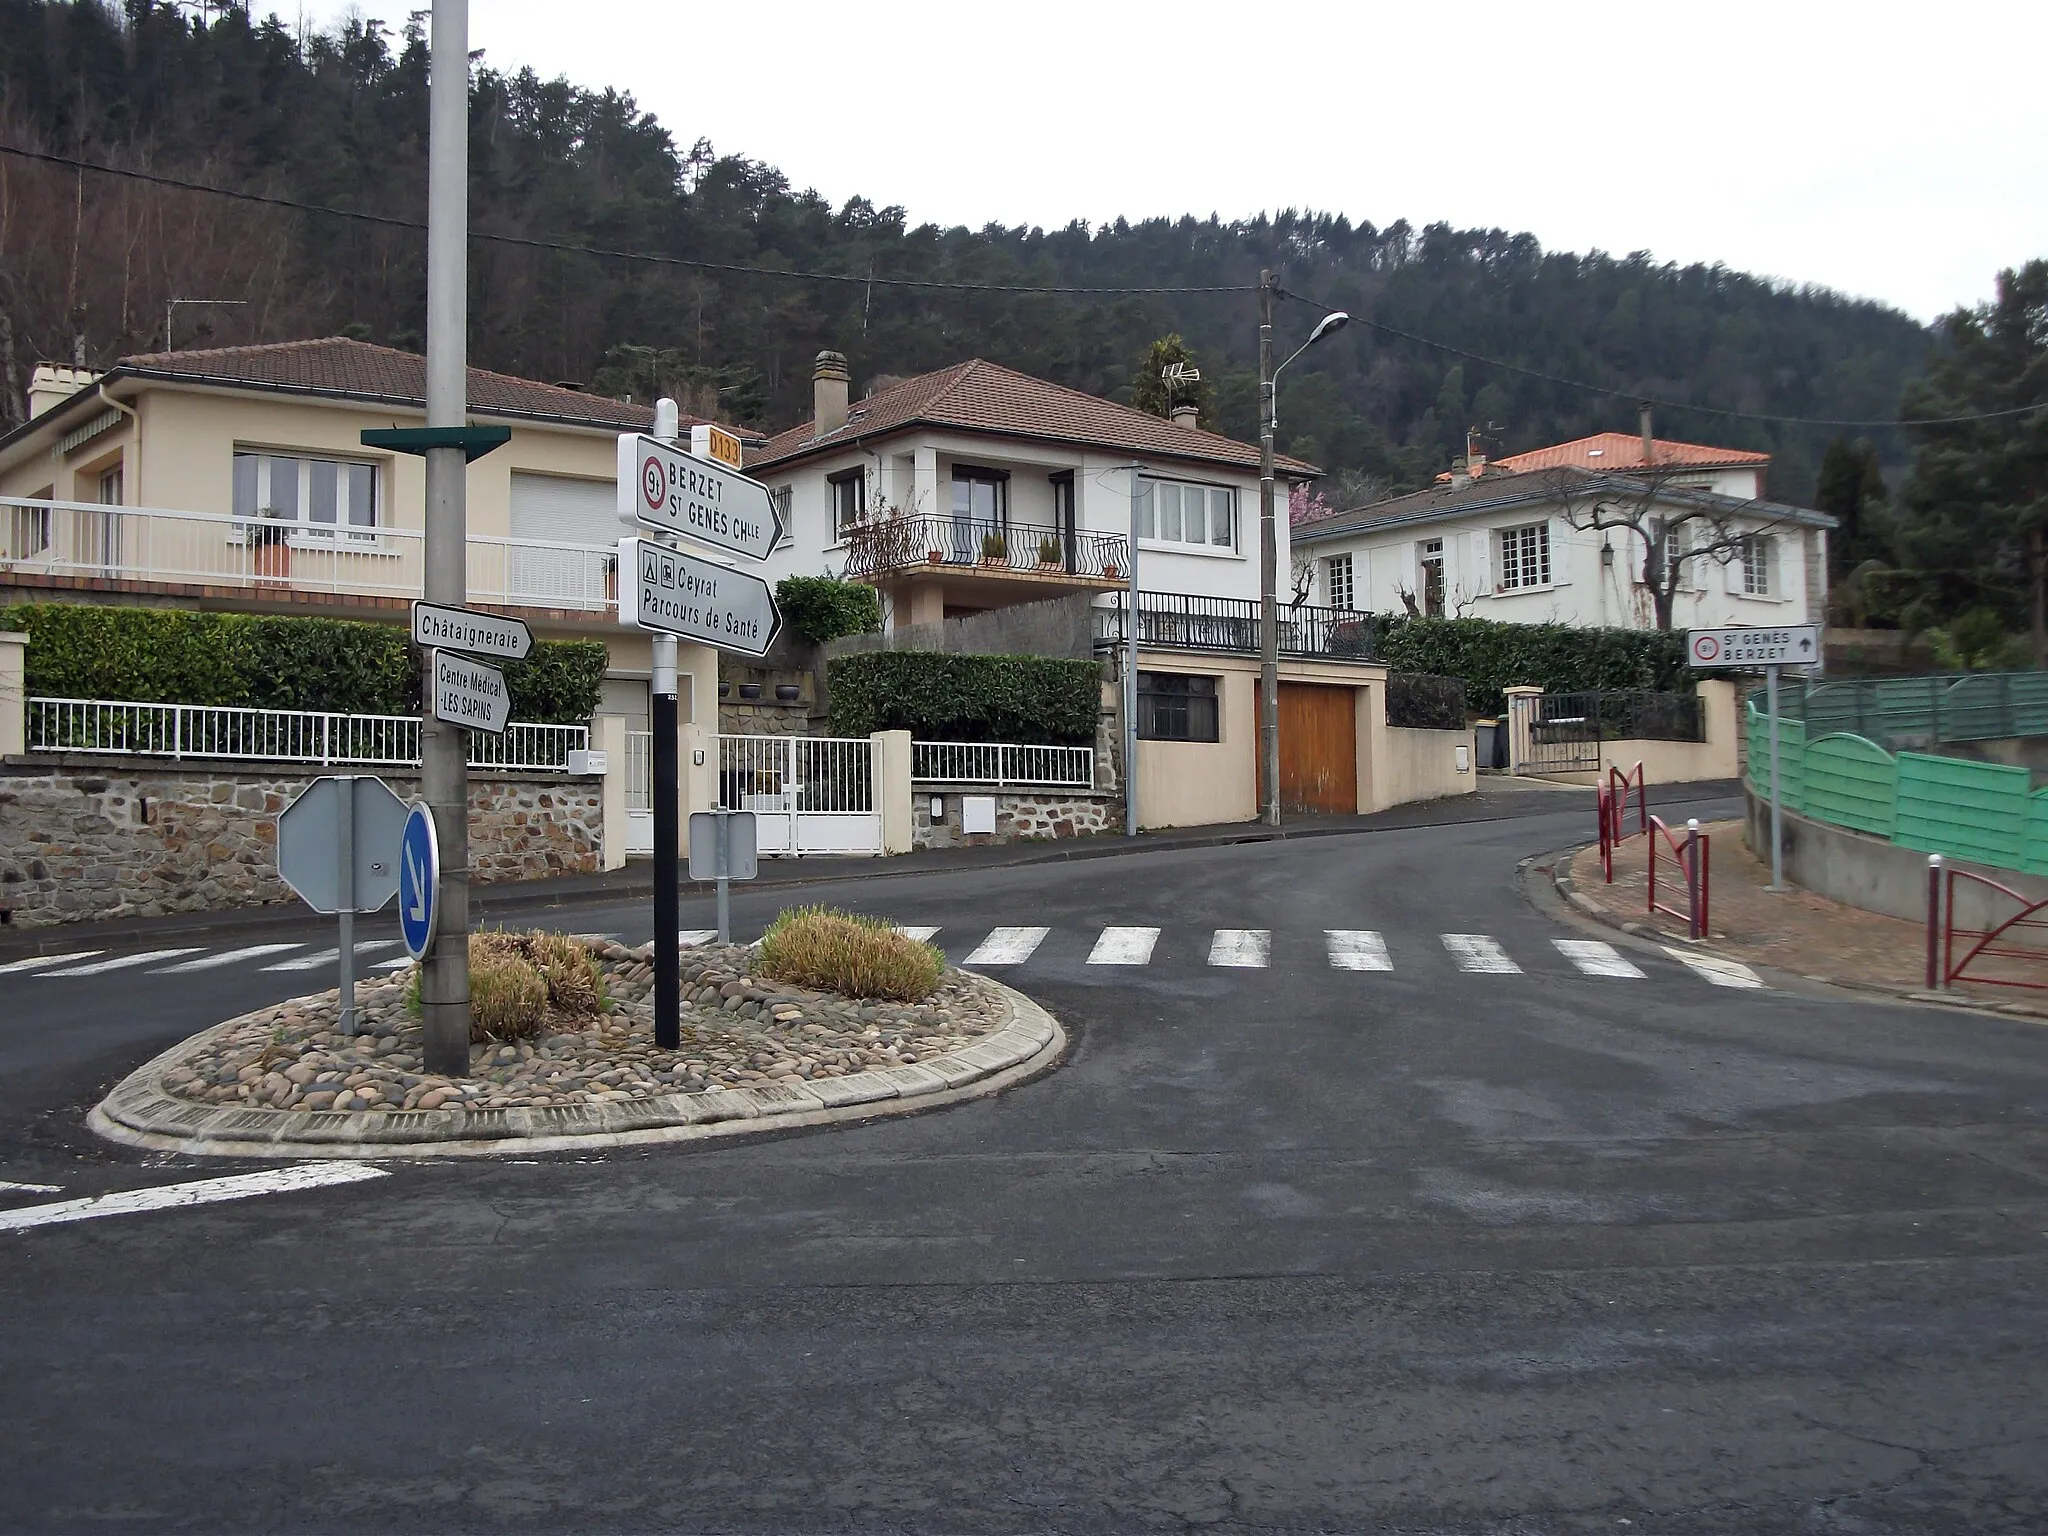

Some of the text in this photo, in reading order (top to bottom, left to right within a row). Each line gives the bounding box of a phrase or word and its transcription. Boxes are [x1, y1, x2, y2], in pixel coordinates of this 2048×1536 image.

[710, 433, 740, 466] D133
[648, 470, 660, 496] 9t
[669, 462, 723, 503] BERZET
[688, 504, 728, 537] GENÈS
[678, 567, 717, 600] Ceyrat
[643, 588, 758, 638] Parcours de Santé
[422, 615, 518, 649] Châtaigneraie
[1724, 647, 1786, 660] BERZET
[440, 663, 501, 698] Centre Médical
[461, 697, 491, 721] SAPINS
